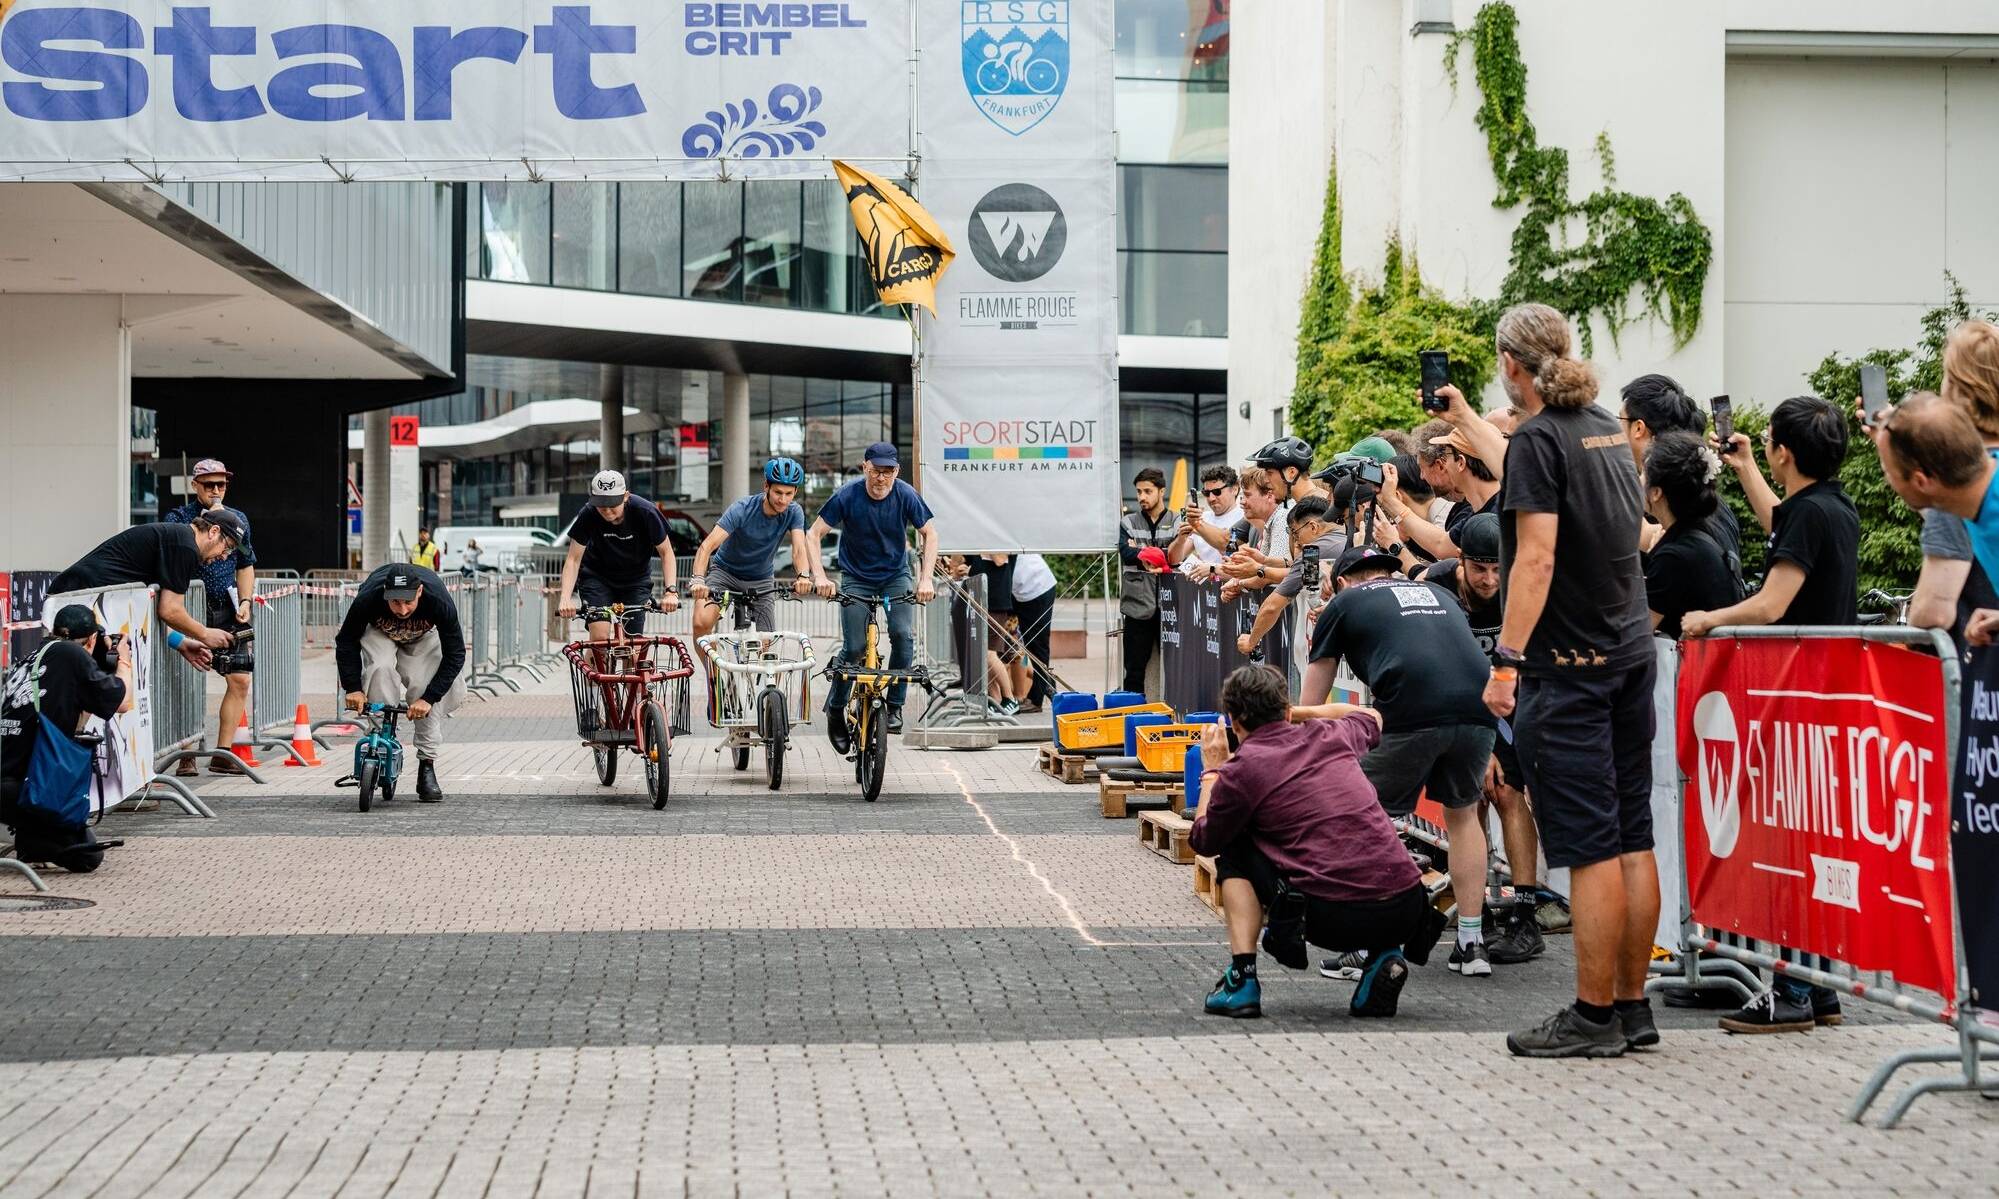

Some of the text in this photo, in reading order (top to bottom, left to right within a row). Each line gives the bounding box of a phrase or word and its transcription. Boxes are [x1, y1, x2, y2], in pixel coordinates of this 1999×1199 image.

[685, 4, 867, 28] BEMBEL
[685, 31, 792, 55] CRIT
[1, 5, 648, 121] Start
[982, 97, 1052, 117] FRANKFURT
[960, 296, 1077, 318] FLAMME ROUGE
[391, 421, 415, 441] 12
[943, 420, 1097, 445] SPORTSTADT
[943, 462, 1094, 472] FRANKFURT AM MAIN
[1745, 719, 1844, 839] FLAMME
